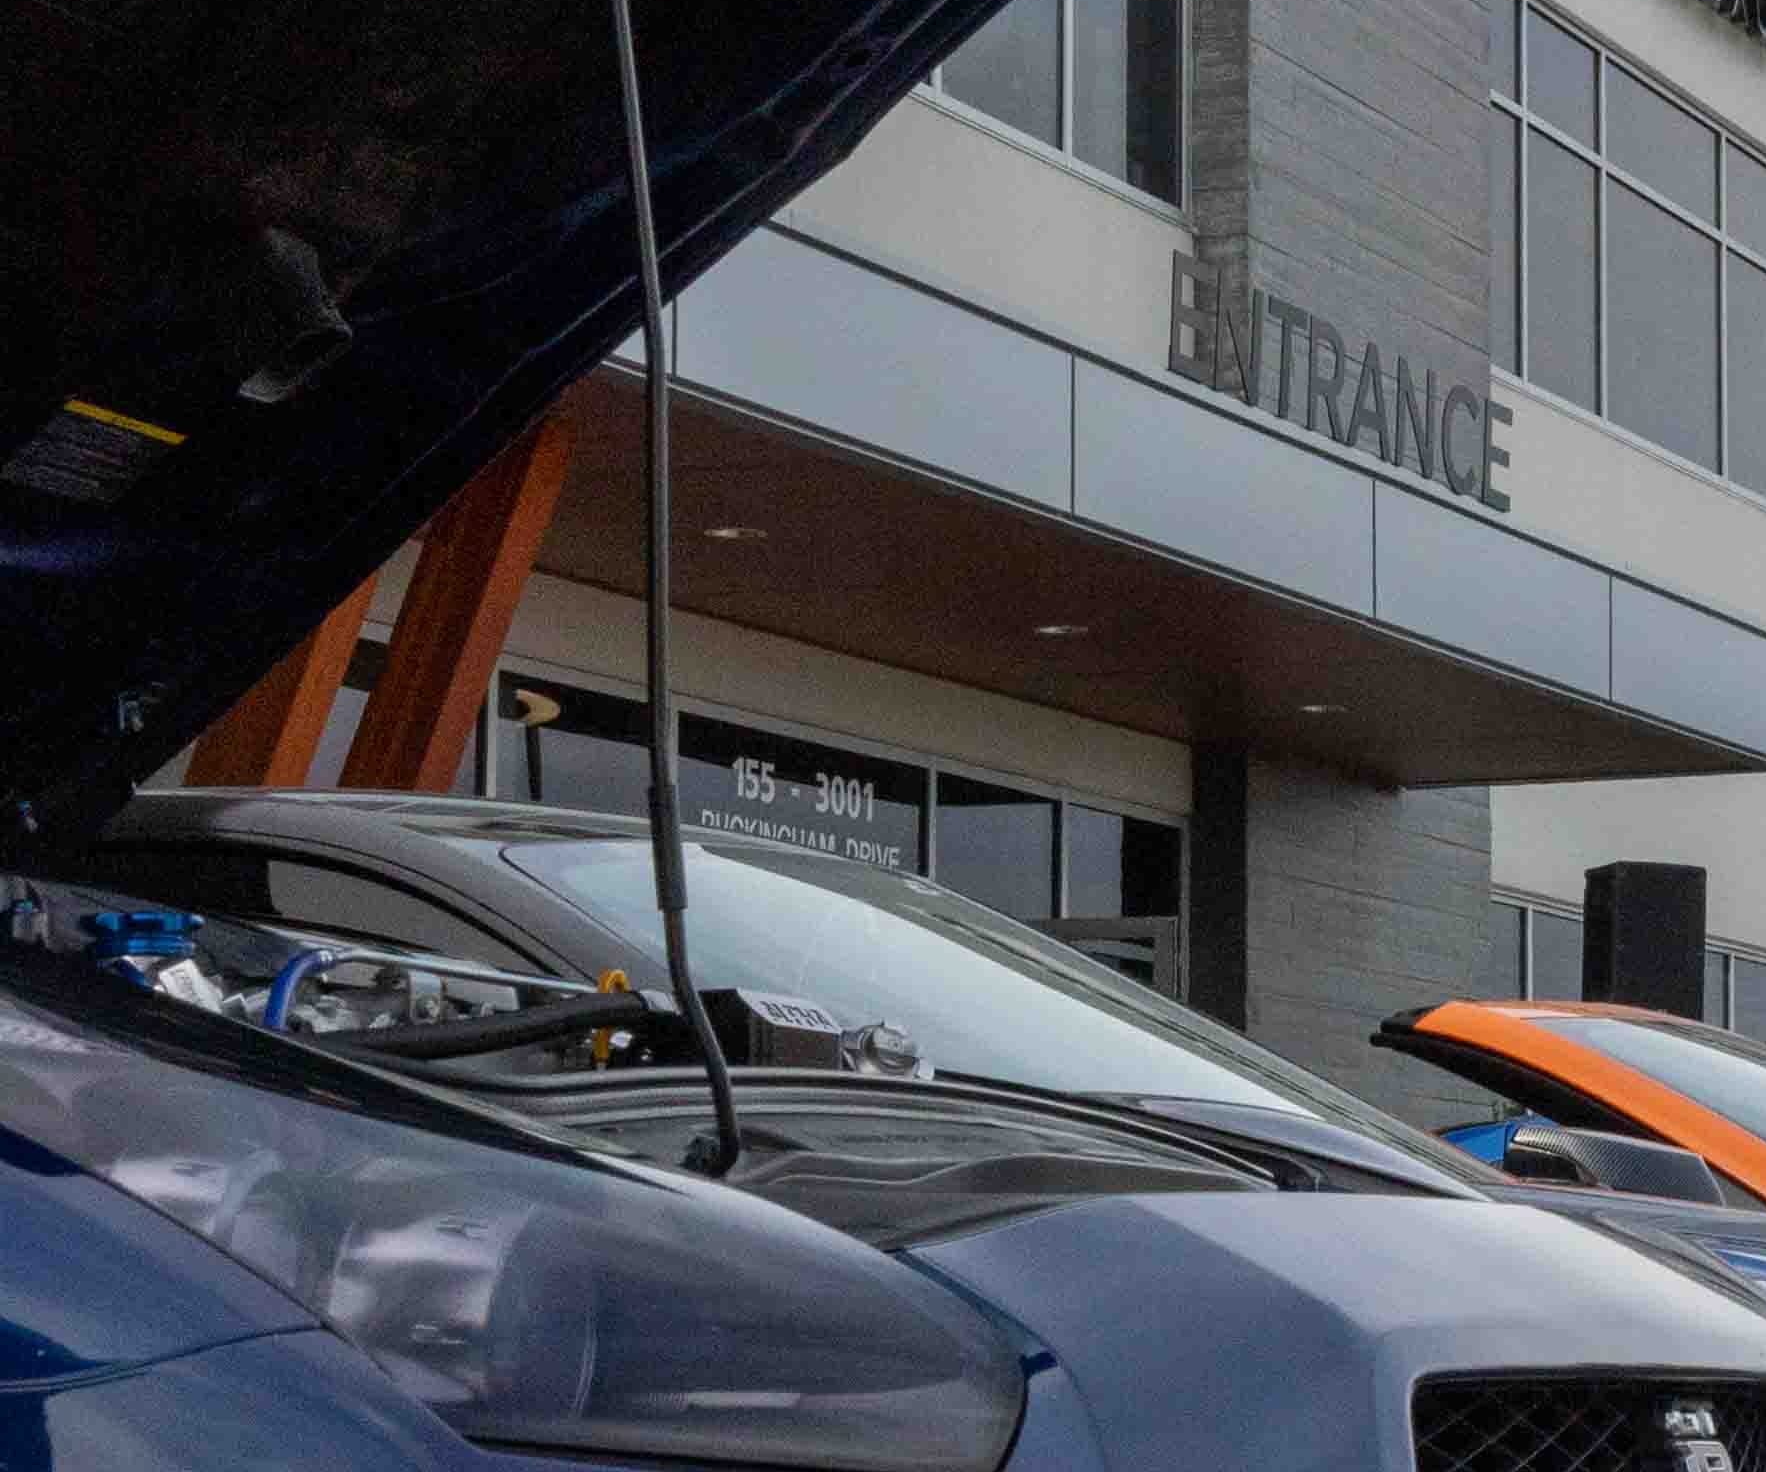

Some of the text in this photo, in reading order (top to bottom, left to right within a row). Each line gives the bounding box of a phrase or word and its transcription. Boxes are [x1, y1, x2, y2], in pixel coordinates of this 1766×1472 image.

[1167, 247, 1514, 514] ENTRANCE
[732, 756, 776, 804] 155
[815, 771, 875, 823] 3001
